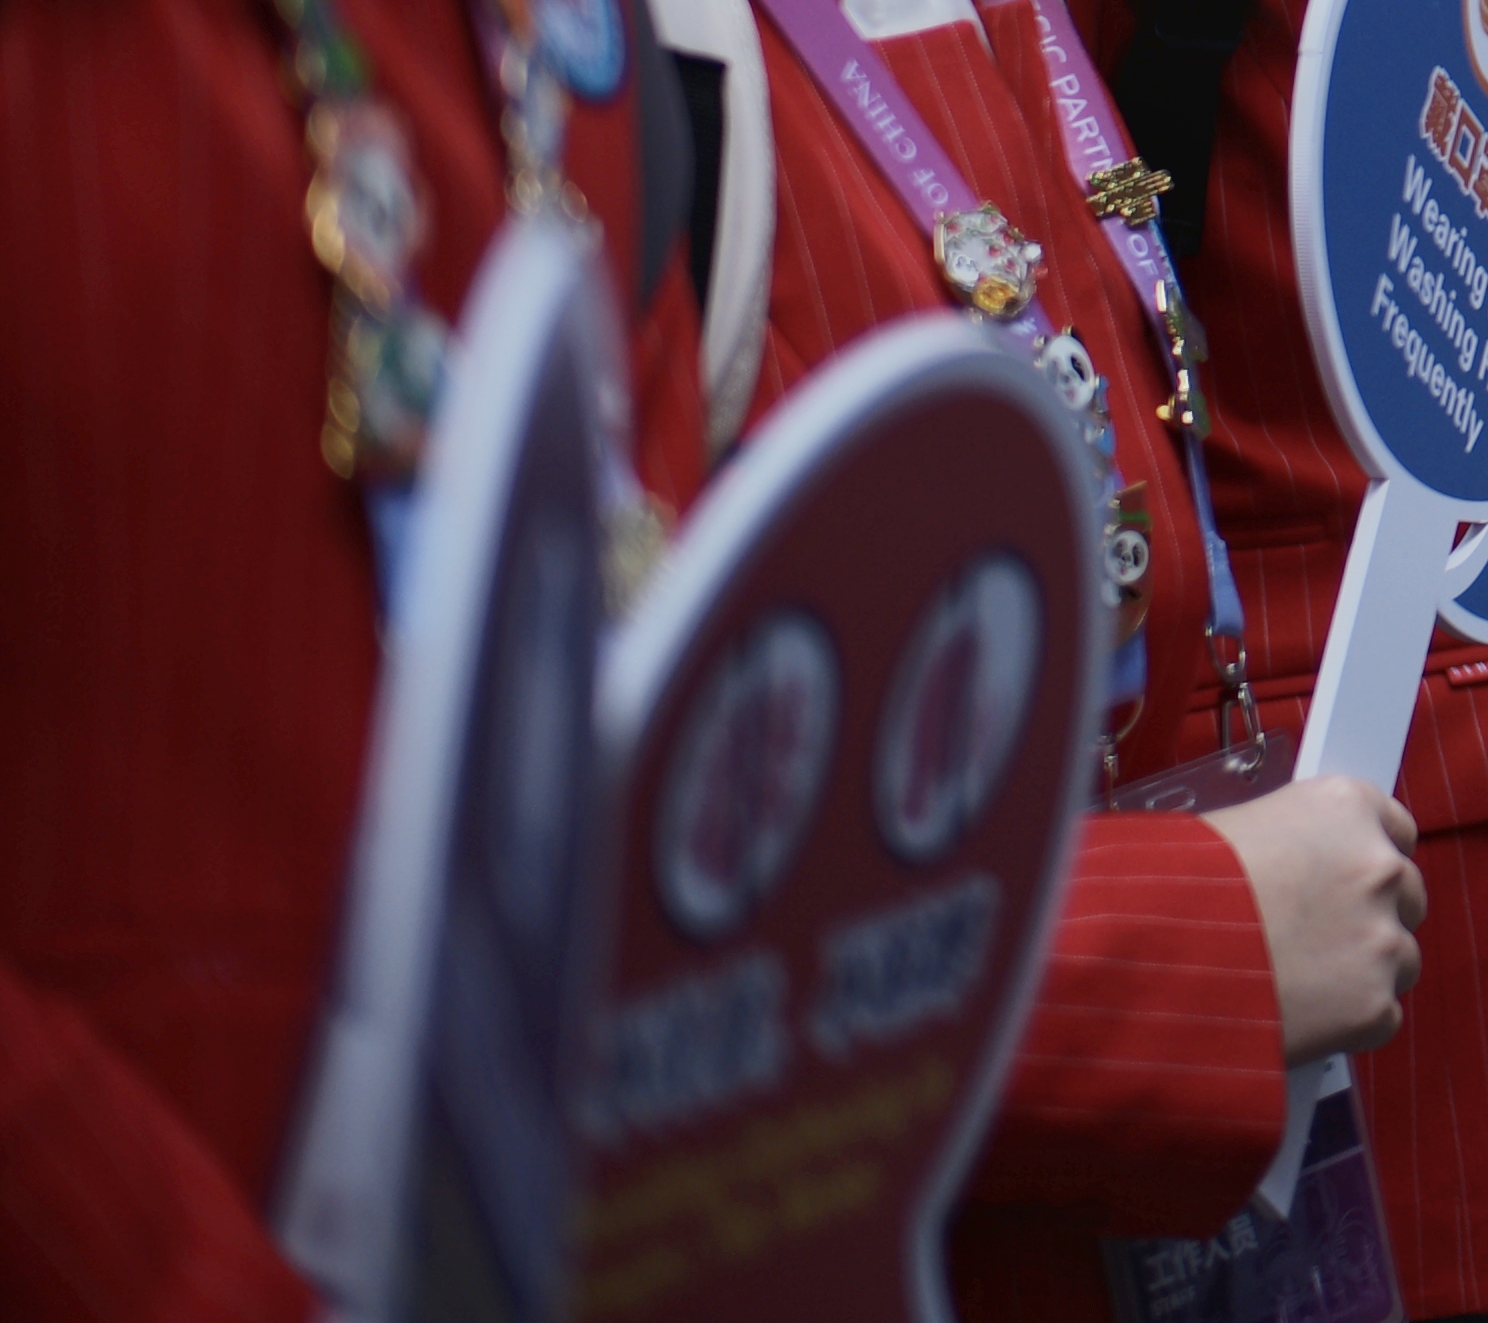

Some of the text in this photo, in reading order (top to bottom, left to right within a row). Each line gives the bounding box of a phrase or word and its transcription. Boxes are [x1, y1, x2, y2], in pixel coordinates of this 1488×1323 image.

[840, 58, 949, 205] OF CHINA
[1049, 72, 1115, 175] PARTN
[1126, 233, 1158, 277] OF
[1370, 272, 1485, 455] Frequently
[1386, 212, 1479, 373] Washing
